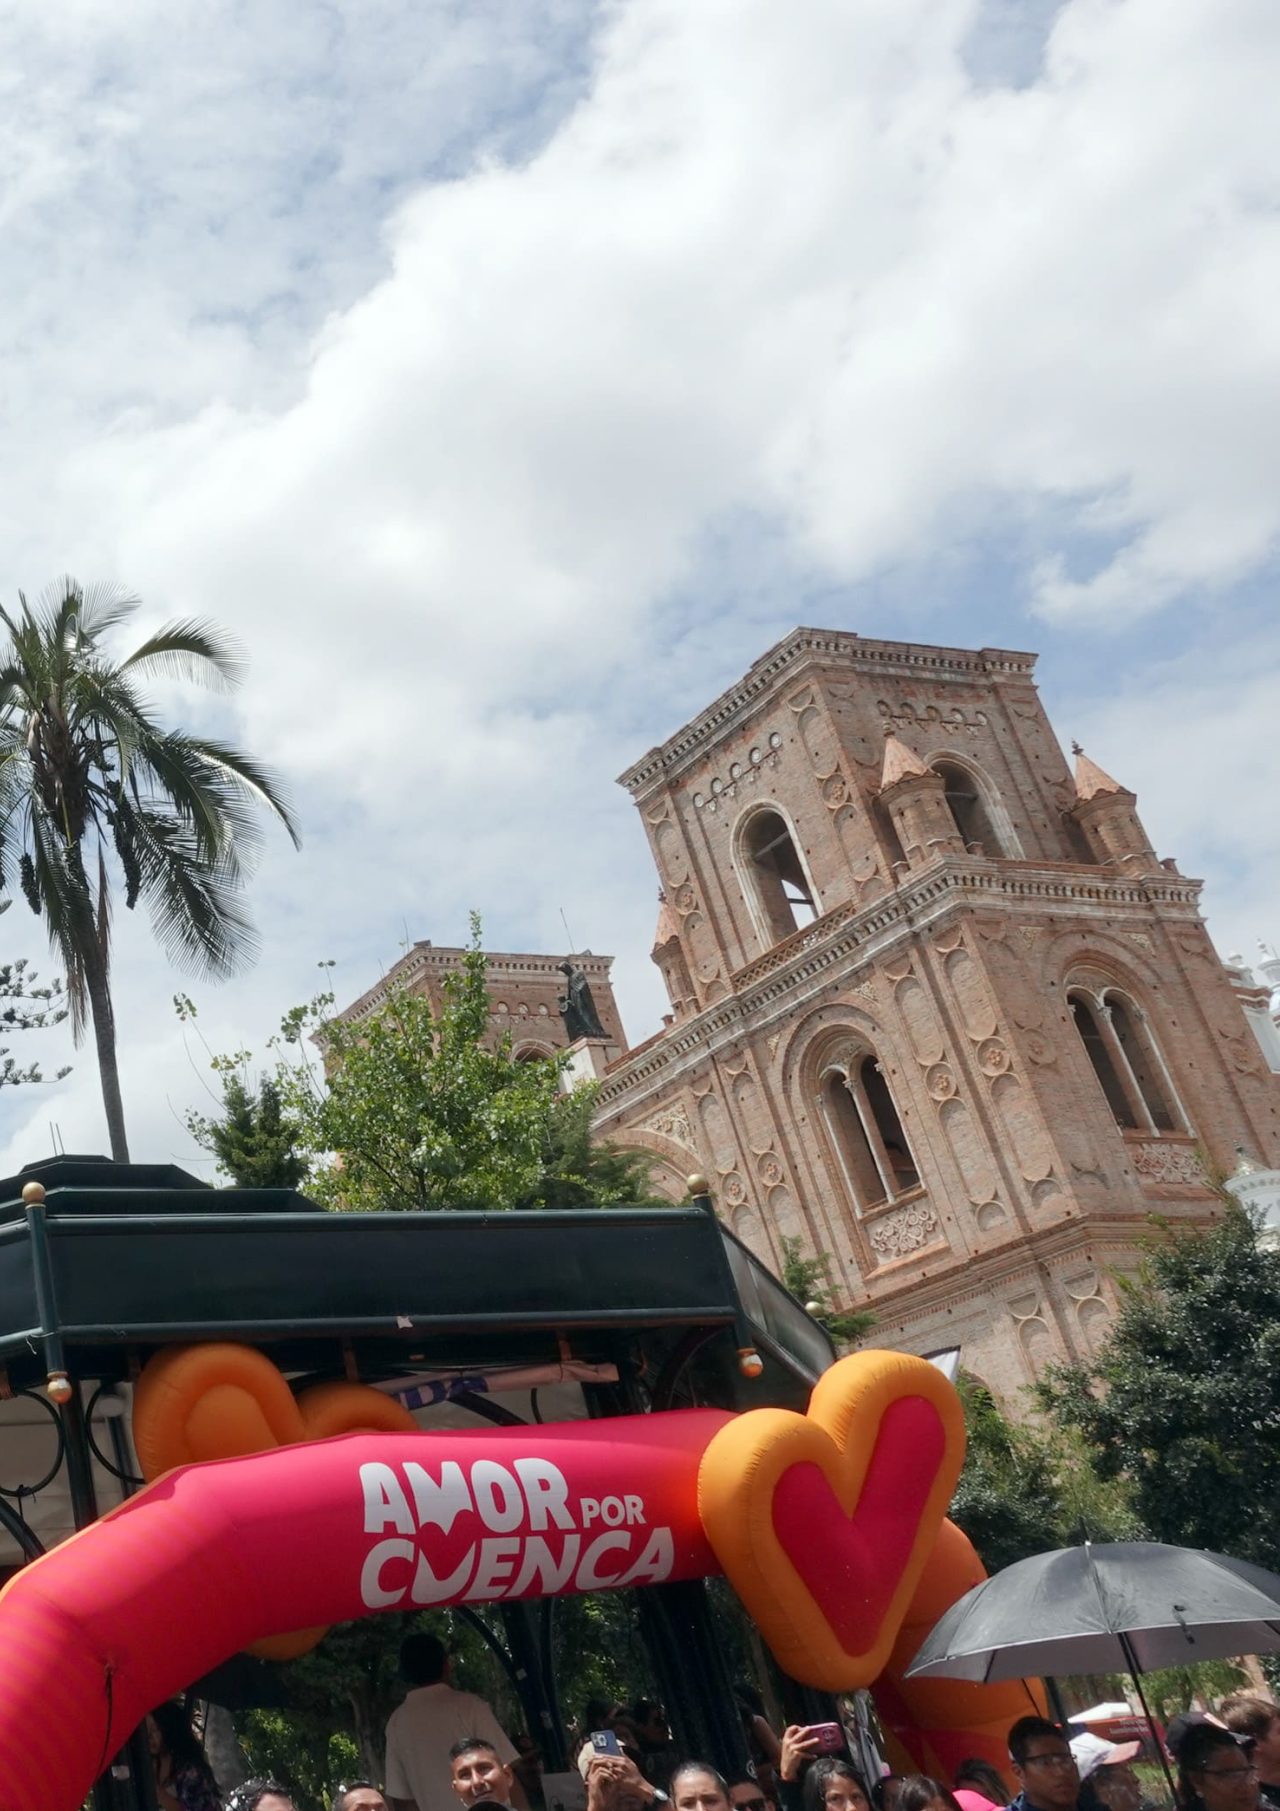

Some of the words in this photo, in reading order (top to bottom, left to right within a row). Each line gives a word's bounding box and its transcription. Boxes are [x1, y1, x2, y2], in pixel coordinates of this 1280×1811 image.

[359, 1457, 576, 1535] AMOR
[580, 1495, 646, 1528] POR
[360, 1527, 674, 1609] CUENCA
